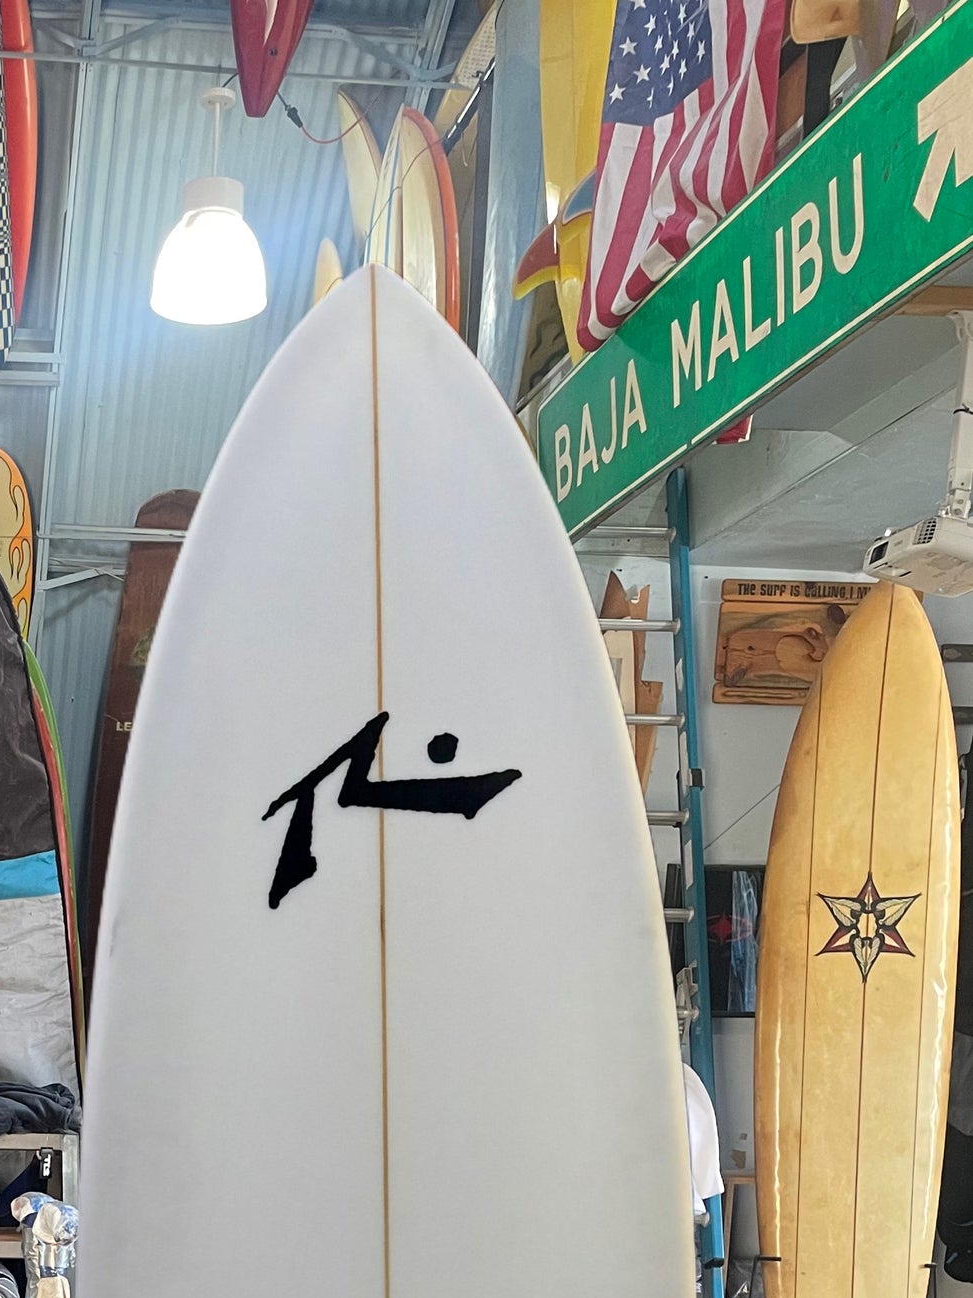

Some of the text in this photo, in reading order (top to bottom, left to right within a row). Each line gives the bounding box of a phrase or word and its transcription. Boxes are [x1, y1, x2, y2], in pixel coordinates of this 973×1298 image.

[554, 152, 865, 503] BAJA MALIBU
[790, 585, 800, 597] IS
